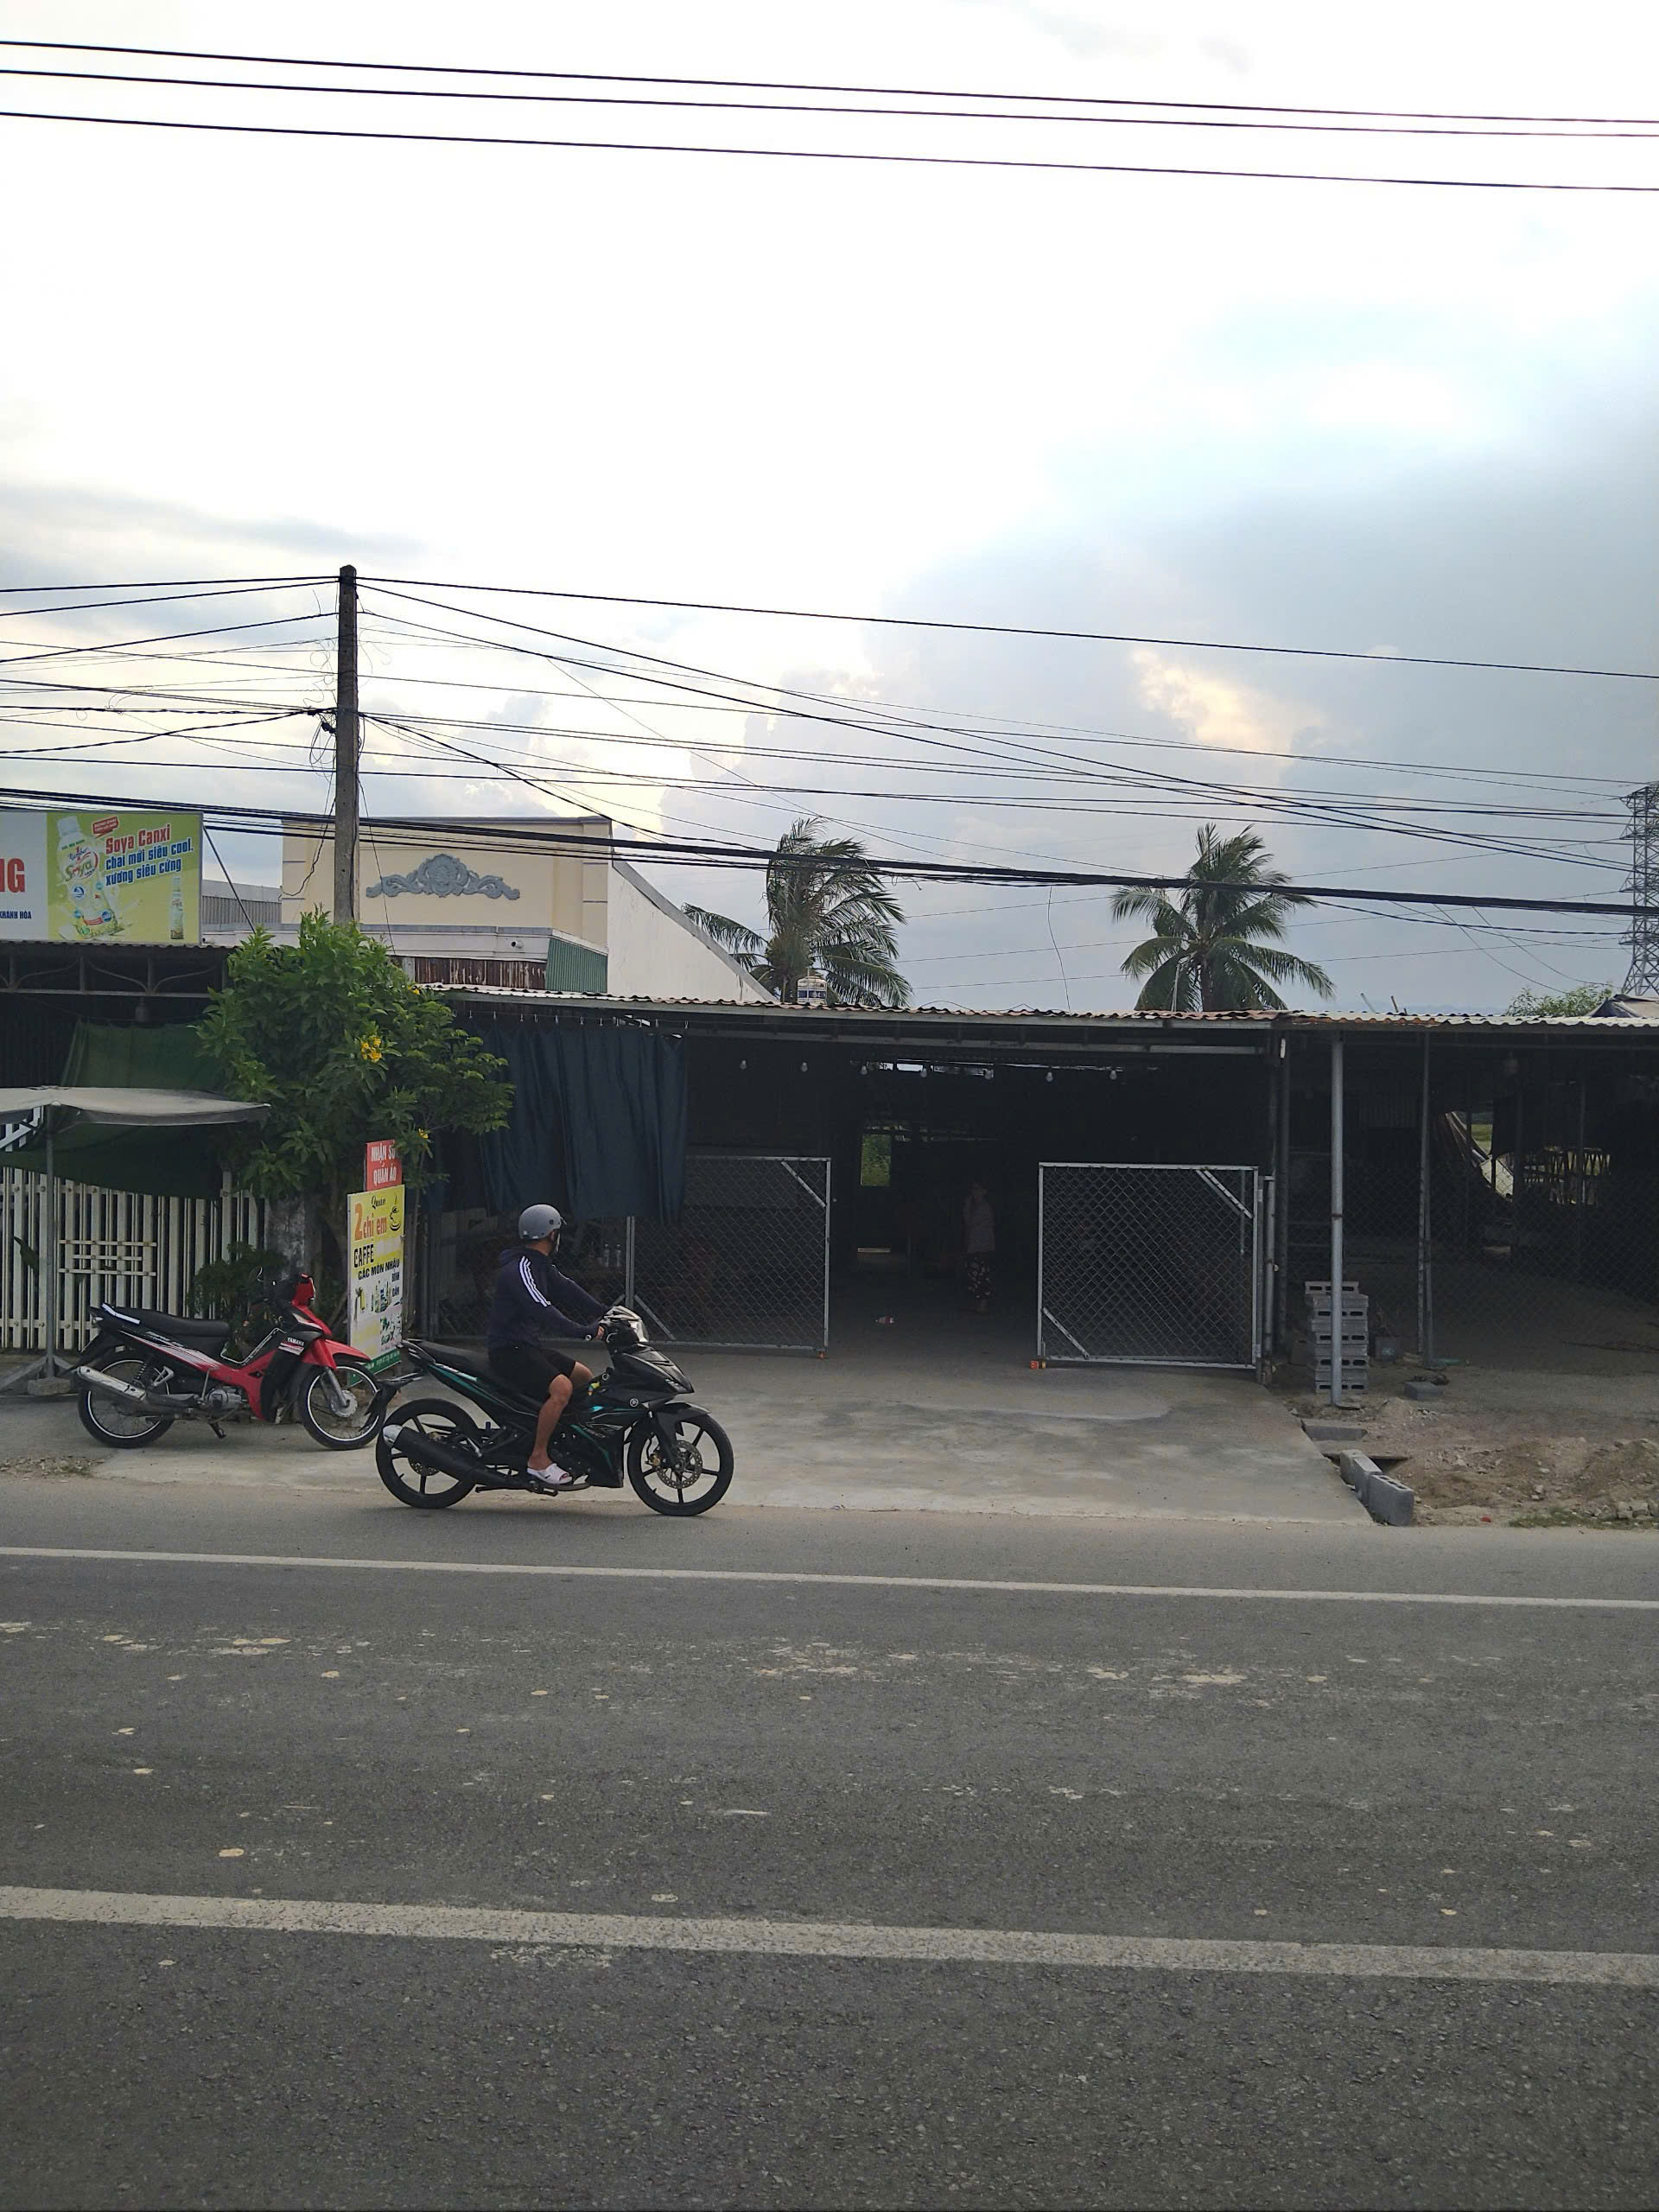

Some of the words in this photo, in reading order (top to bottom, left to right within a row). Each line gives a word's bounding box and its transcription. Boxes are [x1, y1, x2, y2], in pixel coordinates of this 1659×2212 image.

[105, 836, 135, 855] Soya
[138, 823, 170, 847] Canxi
[105, 855, 125, 870] chai
[129, 849, 145, 865] mới
[148, 845, 168, 861] siêu
[105, 870, 134, 886] xương
[137, 864, 156, 879] siêu
[159, 859, 181, 874] cứng
[354, 1203, 363, 1241] 2
[377, 1217, 387, 1236] em
[353, 1244, 374, 1268] CAFFE
[287, 1337, 304, 1347] YAMAHA
